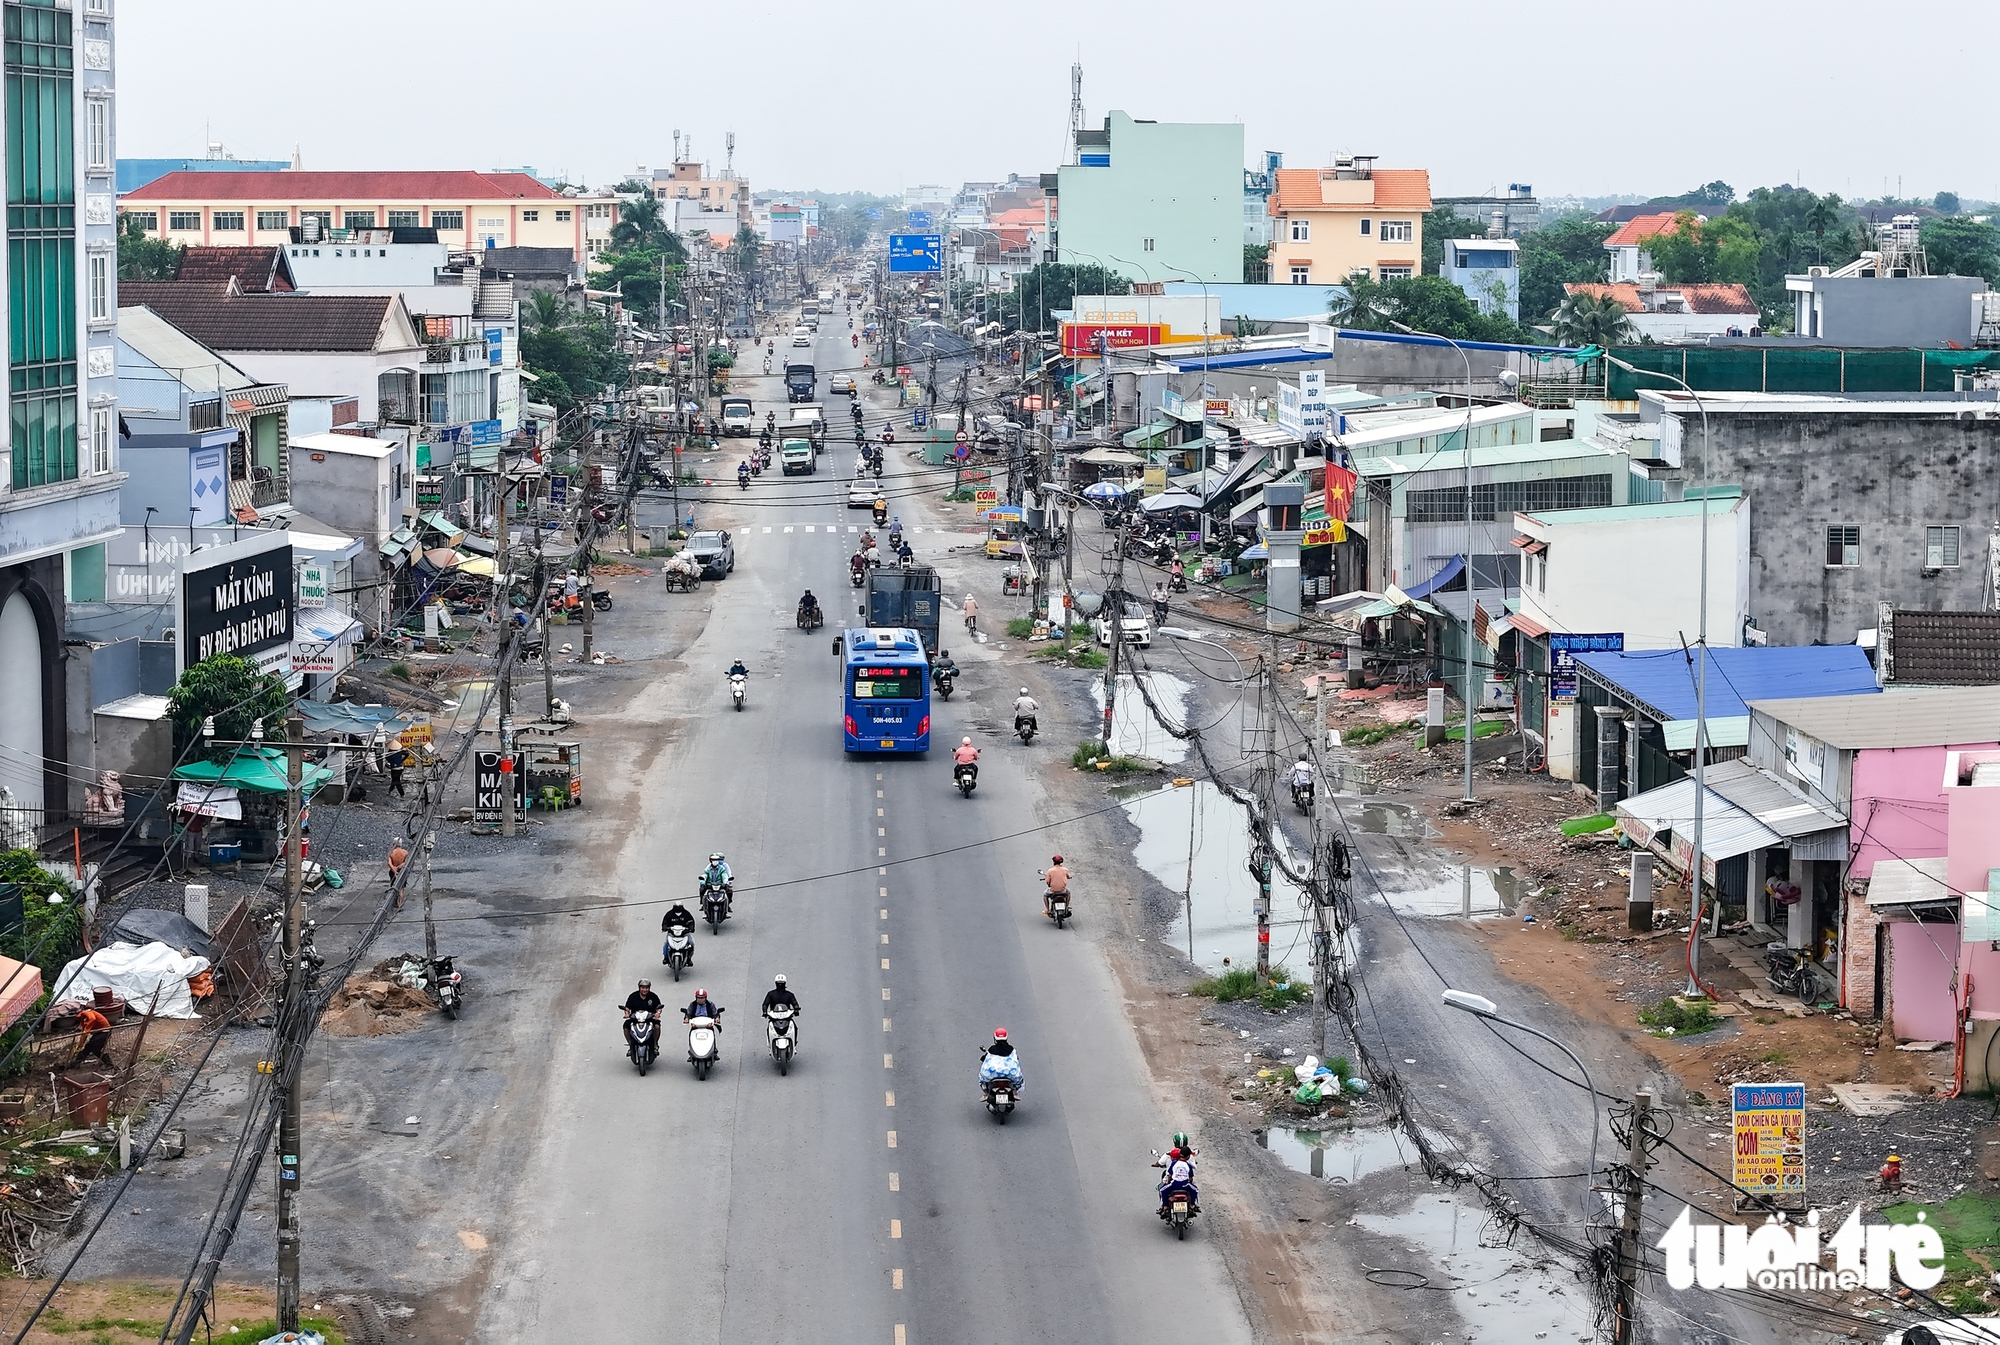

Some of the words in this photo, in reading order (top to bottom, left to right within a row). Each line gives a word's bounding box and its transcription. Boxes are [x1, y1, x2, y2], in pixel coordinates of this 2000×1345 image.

[1116, 328, 1133, 337] KẾT
[1205, 401, 1228, 409] HOTEL
[306, 567, 321, 582] NHÀ
[215, 565, 242, 613] MẮT
[301, 582, 325, 598] THUỐC
[241, 609, 265, 648] BIÊN
[266, 598, 287, 639] PHỦ
[400, 735, 414, 744] HUY
[1751, 1089, 1783, 1107] ĐĂNG
[1785, 1088, 1802, 1107] KÝ
[1736, 1113, 1750, 1128] CƠM
[1736, 1128, 1758, 1156] CƠM
